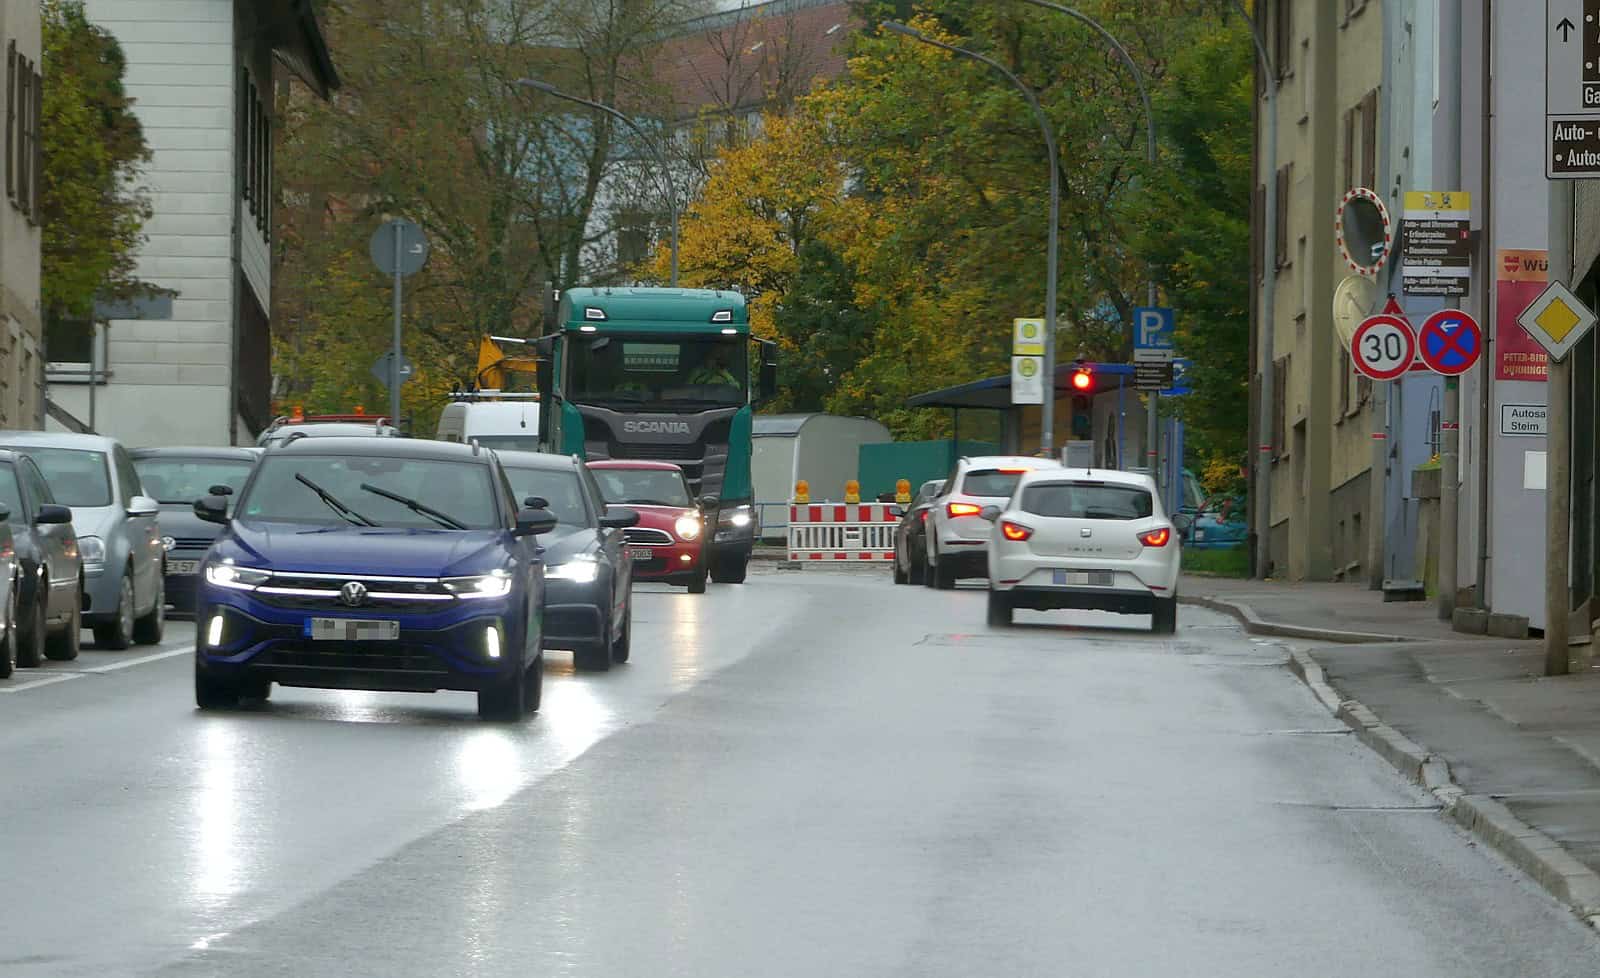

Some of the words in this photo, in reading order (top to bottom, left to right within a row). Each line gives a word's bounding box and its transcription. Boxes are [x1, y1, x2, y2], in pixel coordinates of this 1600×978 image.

[1554, 123, 1593, 141] Auto-
[1365, 333, 1401, 362] 30
[623, 421, 691, 434] SCANIA
[1511, 422, 1539, 432] Steim
